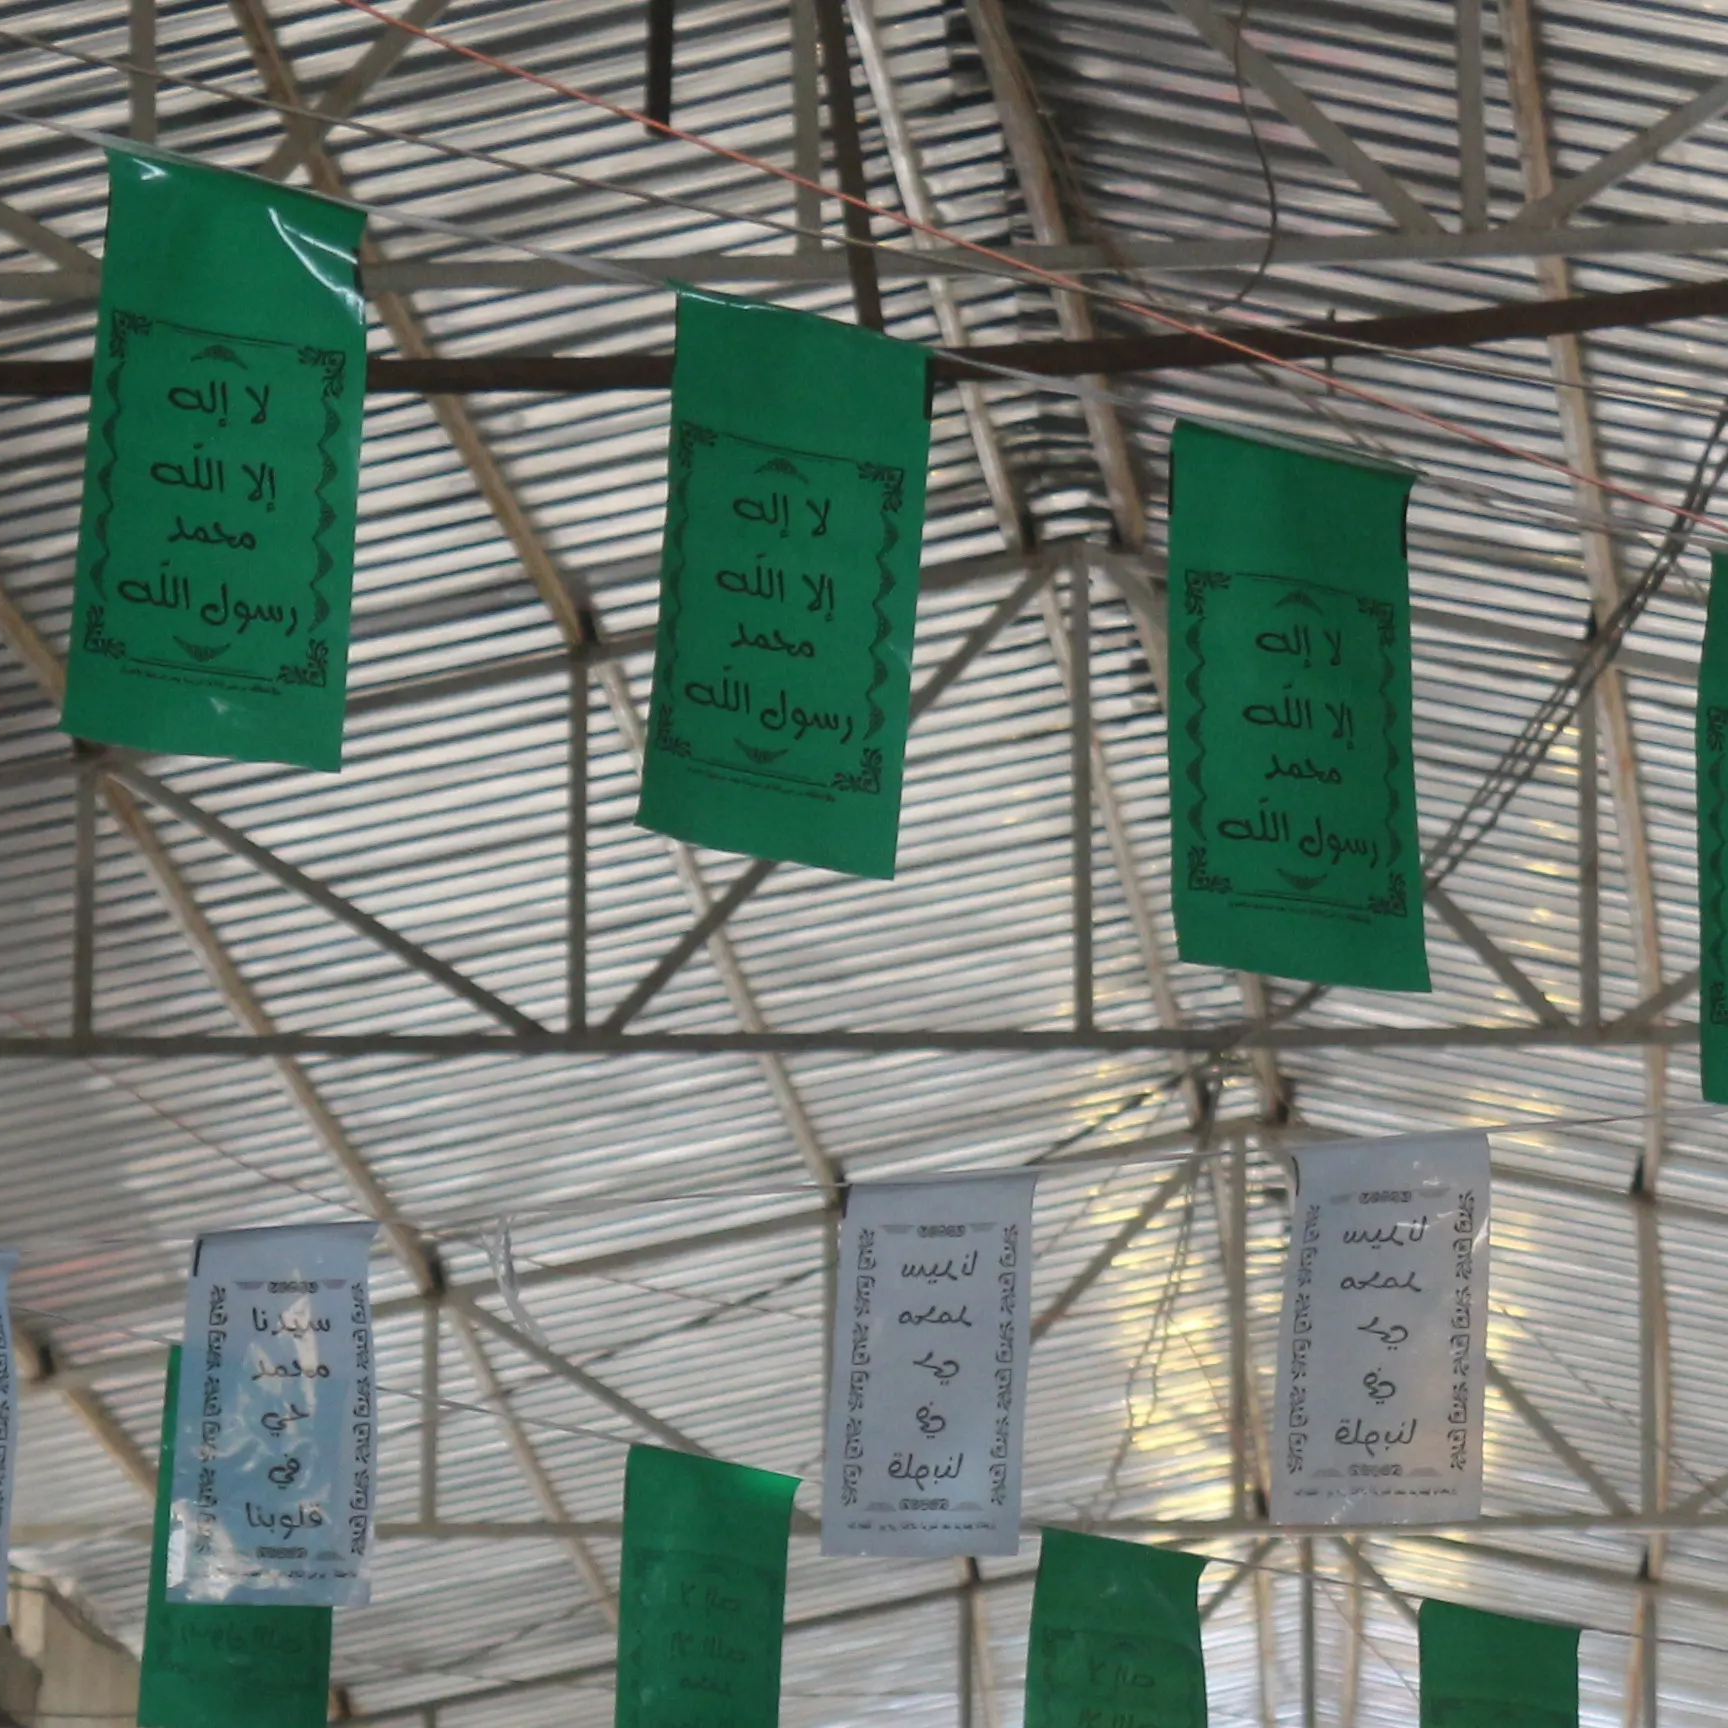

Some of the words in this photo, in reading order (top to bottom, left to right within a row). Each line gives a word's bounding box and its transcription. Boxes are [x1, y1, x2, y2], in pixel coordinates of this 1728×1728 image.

[245, 384, 270, 425] لا
[150, 442, 224, 493] الله
[167, 515, 257, 551] محمد
[806, 498, 831, 538] لا
[117, 560, 190, 610] الله
[715, 553, 785, 602] الله
[200, 582, 298, 635] رسول
[730, 622, 815, 658] محمد
[1323, 629, 1341, 667] لا
[684, 665, 750, 714] الله
[1242, 683, 1313, 729] الله
[759, 690, 853, 745] رسول
[1264, 754, 1342, 784] محمد
[1216, 797, 1290, 843] الله
[1298, 815, 1379, 869] رسول
[260, 1403, 309, 1438] حي
[267, 1454, 302, 1490] في
[245, 1501, 324, 1540] قلوبنا
